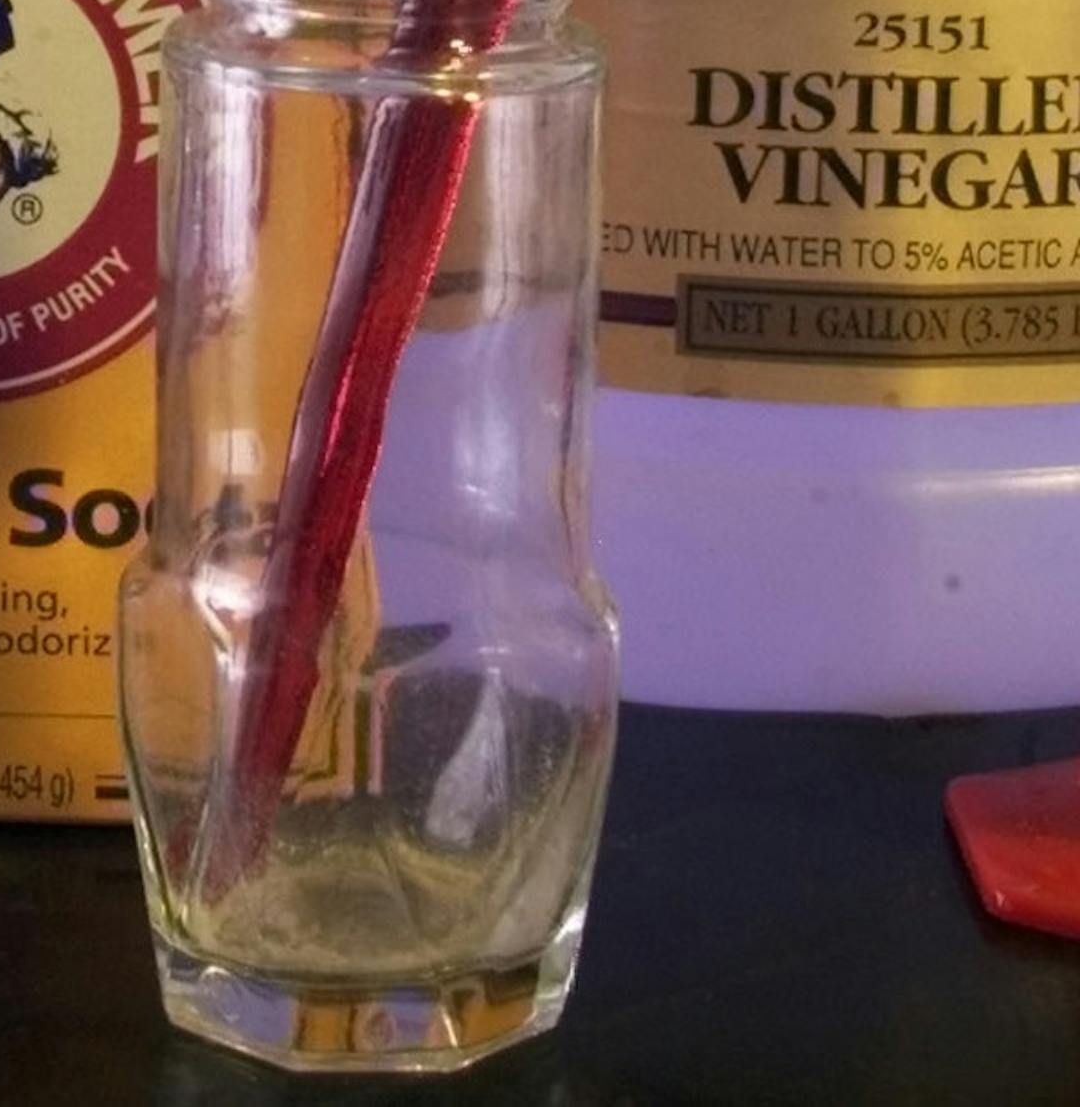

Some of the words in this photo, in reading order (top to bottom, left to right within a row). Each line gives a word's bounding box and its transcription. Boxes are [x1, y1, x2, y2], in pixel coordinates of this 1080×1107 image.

[854, 12, 990, 53] 25151
[643, 227, 721, 261] WITH
[730, 234, 842, 268] WATER
[852, 239, 895, 270] TO
[905, 240, 949, 271] 5%
[956, 239, 1062, 270] ACETIC
[33, 245, 131, 331] PURITY
[705, 299, 773, 335] NET
[786, 305, 799, 335] 1
[816, 306, 950, 342] GALLON
[961, 305, 1060, 346] (3.785
[10, 468, 157, 549] So
[50, 766, 75, 809] g)
